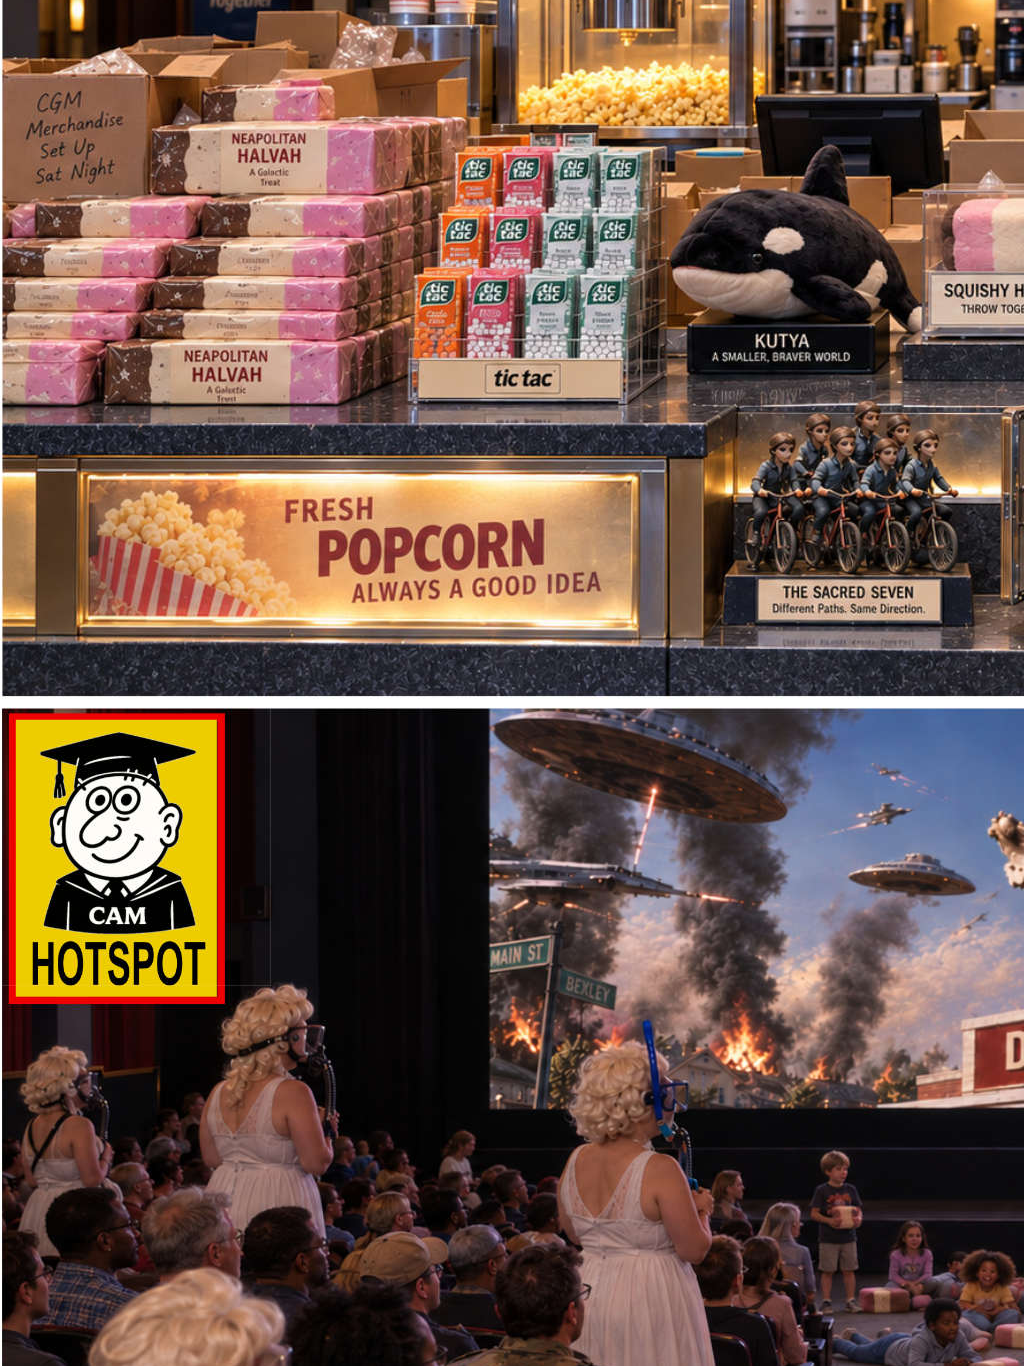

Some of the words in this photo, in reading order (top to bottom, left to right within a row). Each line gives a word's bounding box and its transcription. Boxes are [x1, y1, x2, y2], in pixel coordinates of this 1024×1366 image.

[36, 90, 82, 113] CGM
[26, 113, 123, 140] Merchandise
[232, 133, 306, 144] NEAPOLITAN
[40, 143, 67, 159] Set
[74, 140, 96, 158] Up
[238, 148, 301, 163] HALVAH
[35, 166, 62, 185] Sat
[70, 160, 115, 185] Night
[944, 283, 1010, 298] SQUISHY
[961, 304, 999, 314] THROW
[755, 334, 809, 348] KUTYA
[712, 352, 720, 362] A
[722, 352, 769, 363] SMALLER,
[773, 352, 812, 362] BRAVER
[815, 352, 851, 362] WORLD
[494, 369, 519, 387] tic
[521, 369, 552, 387] tac
[284, 496, 374, 524] FRESH
[317, 518, 546, 578] POPCORN
[351, 579, 441, 604] ALWAYS
[449, 577, 464, 599] A
[471, 575, 536, 598] GOOD
[547, 571, 602, 595] IDEA
[783, 585, 809, 600] THE
[813, 585, 866, 600] SACRED
[870, 585, 914, 600] SEVEN
[772, 603, 815, 614] Different
[818, 603, 847, 614] Paths.
[850, 603, 877, 614] Same
[880, 603, 926, 614] Direction.
[491, 946, 521, 967] MAIN
[528, 943, 544, 961] ST
[566, 976, 611, 1003] BEXLEY
